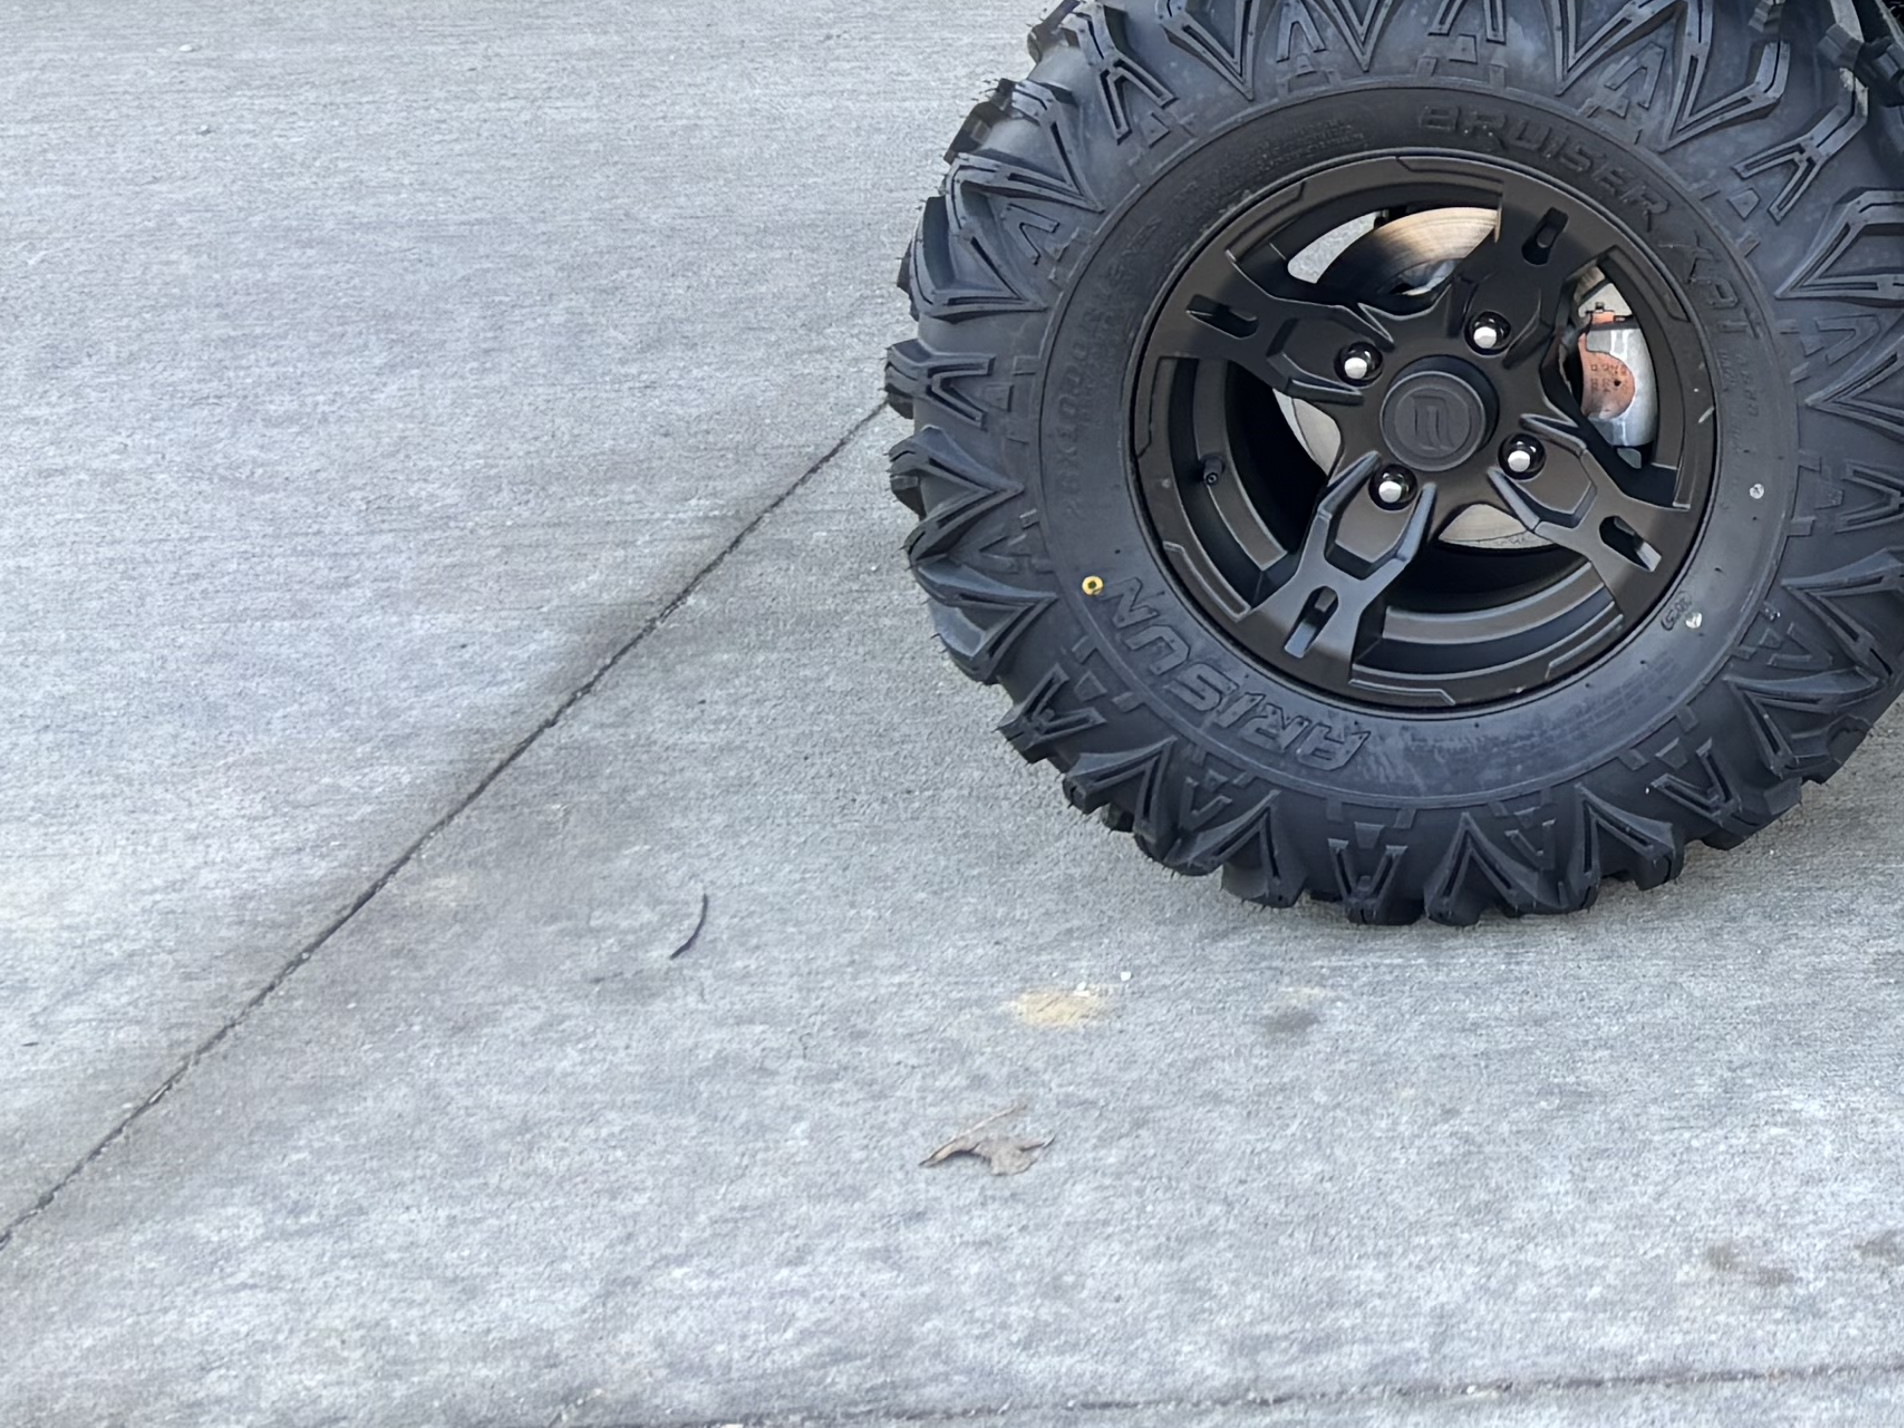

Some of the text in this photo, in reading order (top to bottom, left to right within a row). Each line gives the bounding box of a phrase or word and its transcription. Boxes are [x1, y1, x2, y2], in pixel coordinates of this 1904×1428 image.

[1416, 103, 1670, 234] BRUISER
[1656, 230, 1764, 340] XPT
[1098, 575, 1372, 772] ARISUN
